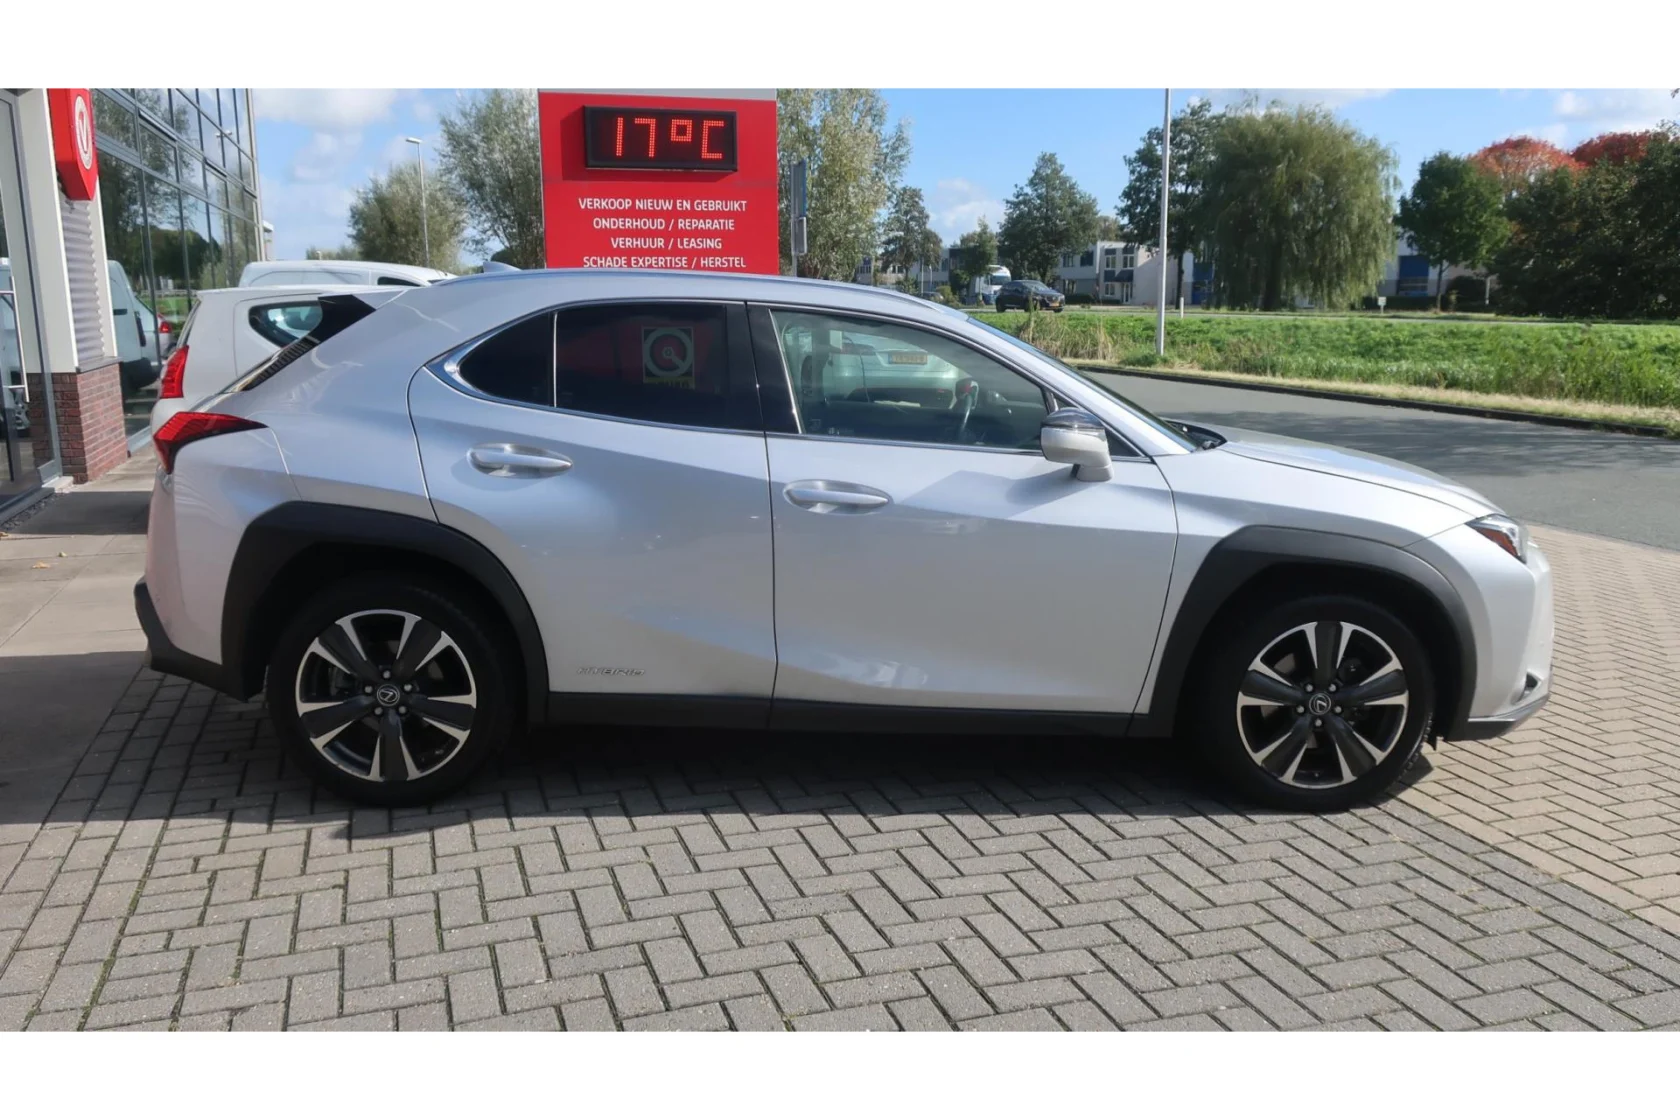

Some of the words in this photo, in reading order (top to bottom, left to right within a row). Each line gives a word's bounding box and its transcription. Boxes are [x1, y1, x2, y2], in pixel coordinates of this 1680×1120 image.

[578, 197, 632, 210] VERKOOP
[635, 198, 673, 211] NIEUW
[676, 199, 691, 211] EN
[693, 199, 747, 212] GEBRUIKT
[592, 217, 666, 230] ONDERHOUD
[677, 218, 735, 231] REPARATIE
[610, 237, 665, 249] VERHUUR
[677, 237, 722, 250] LEASING
[583, 256, 628, 268] SCHADE
[630, 256, 688, 269] EXPERTISE
[700, 256, 747, 268] HERSTEL
